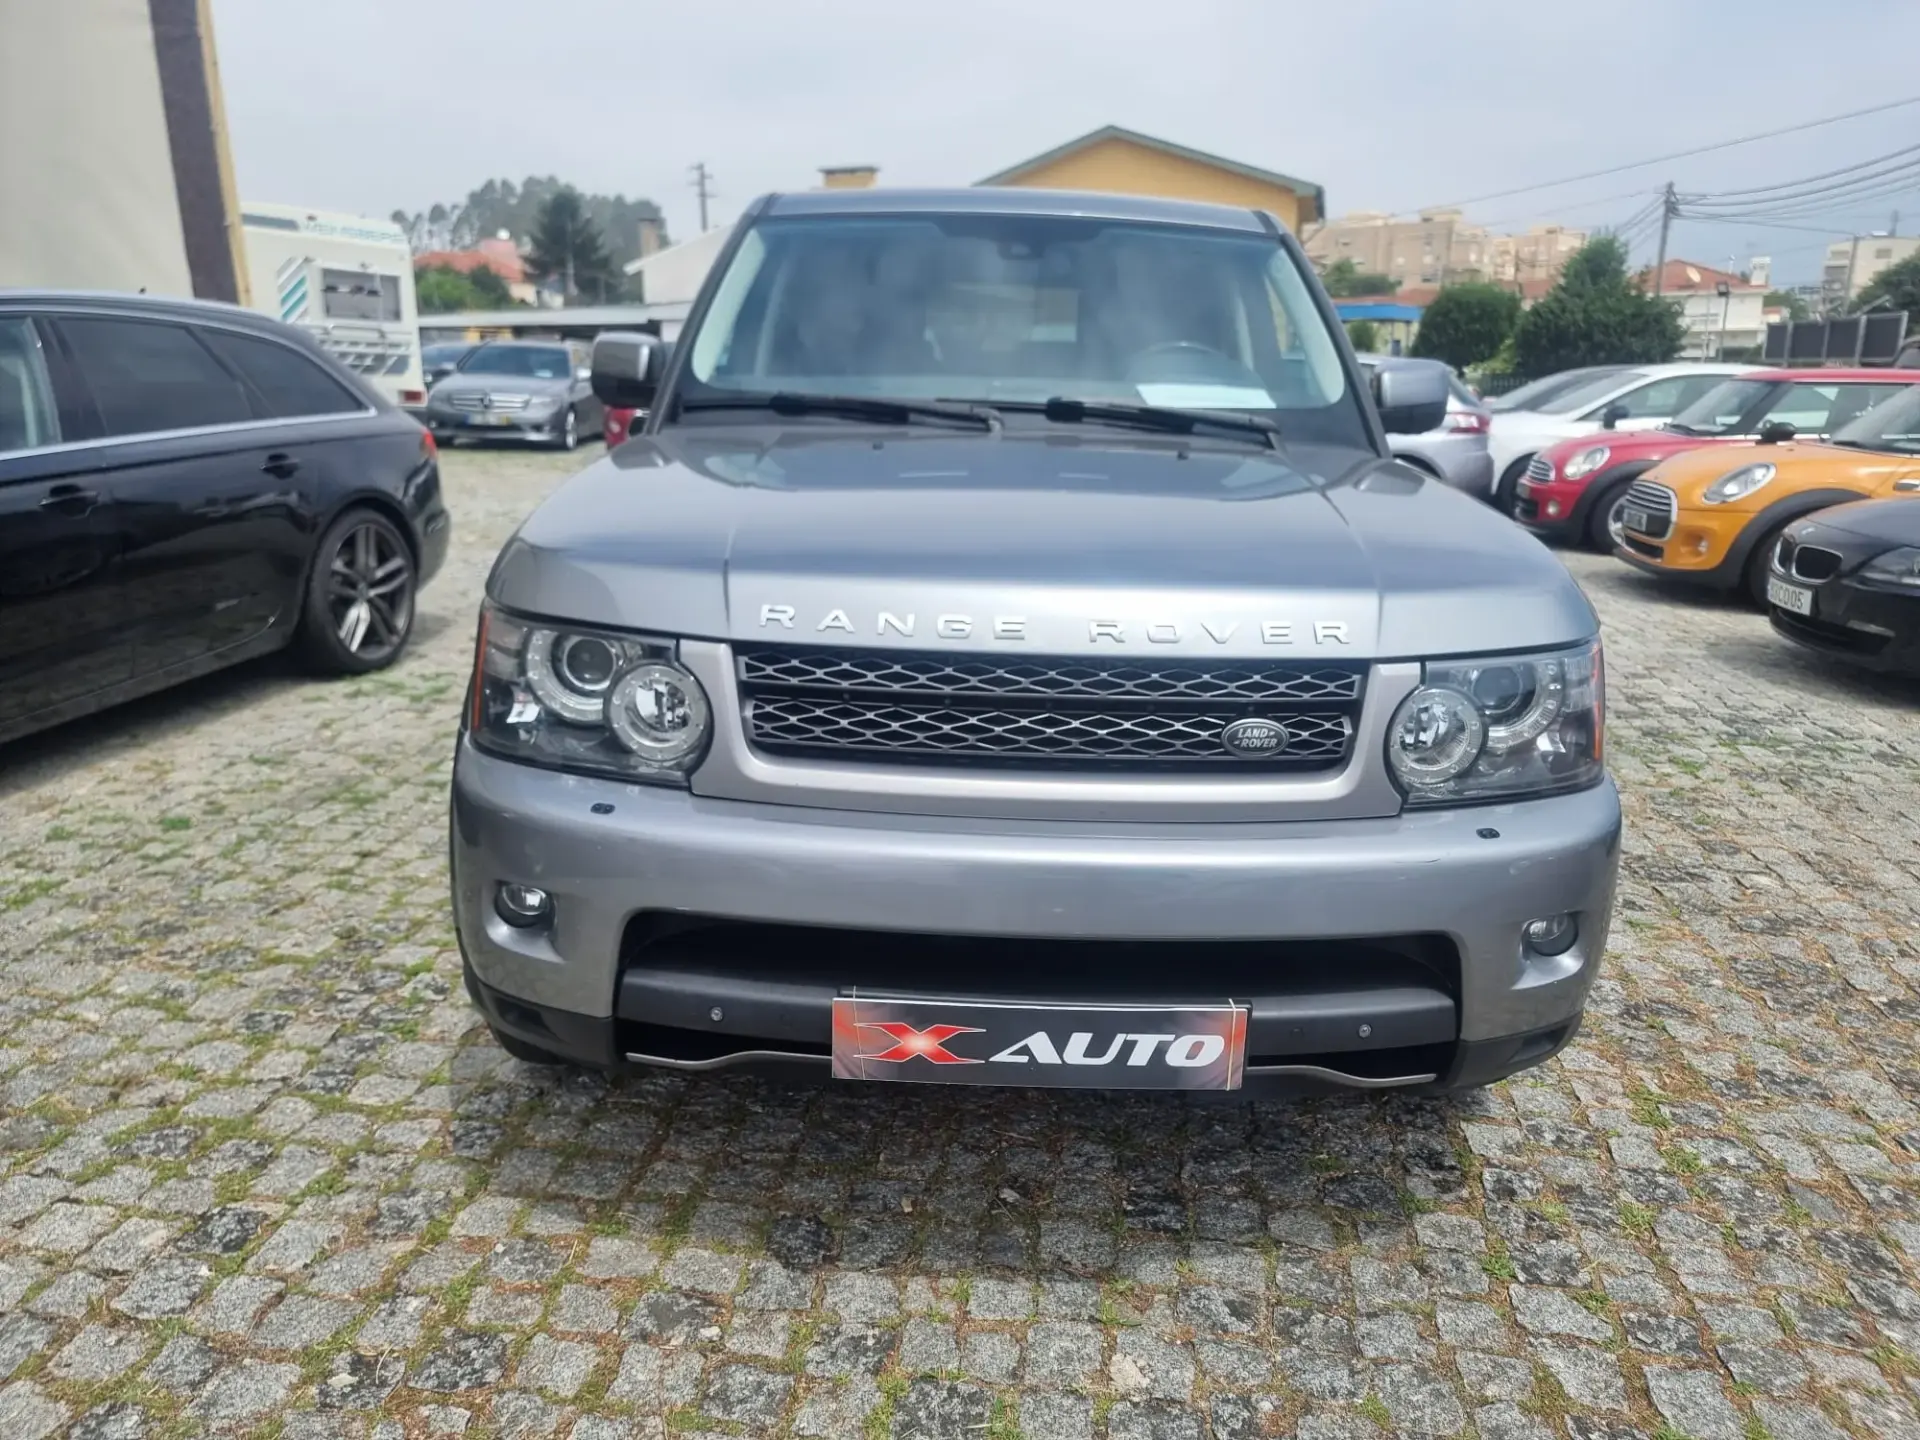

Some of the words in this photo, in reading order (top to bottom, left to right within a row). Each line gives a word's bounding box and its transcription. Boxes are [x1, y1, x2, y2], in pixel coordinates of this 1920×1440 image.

[759, 604, 1027, 640] RANGE
[1088, 619, 1351, 645] ROVER
[1237, 728, 1269, 738] LAND
[1240, 738, 1278, 748] ROVER
[988, 1031, 1225, 1067] AUTO
